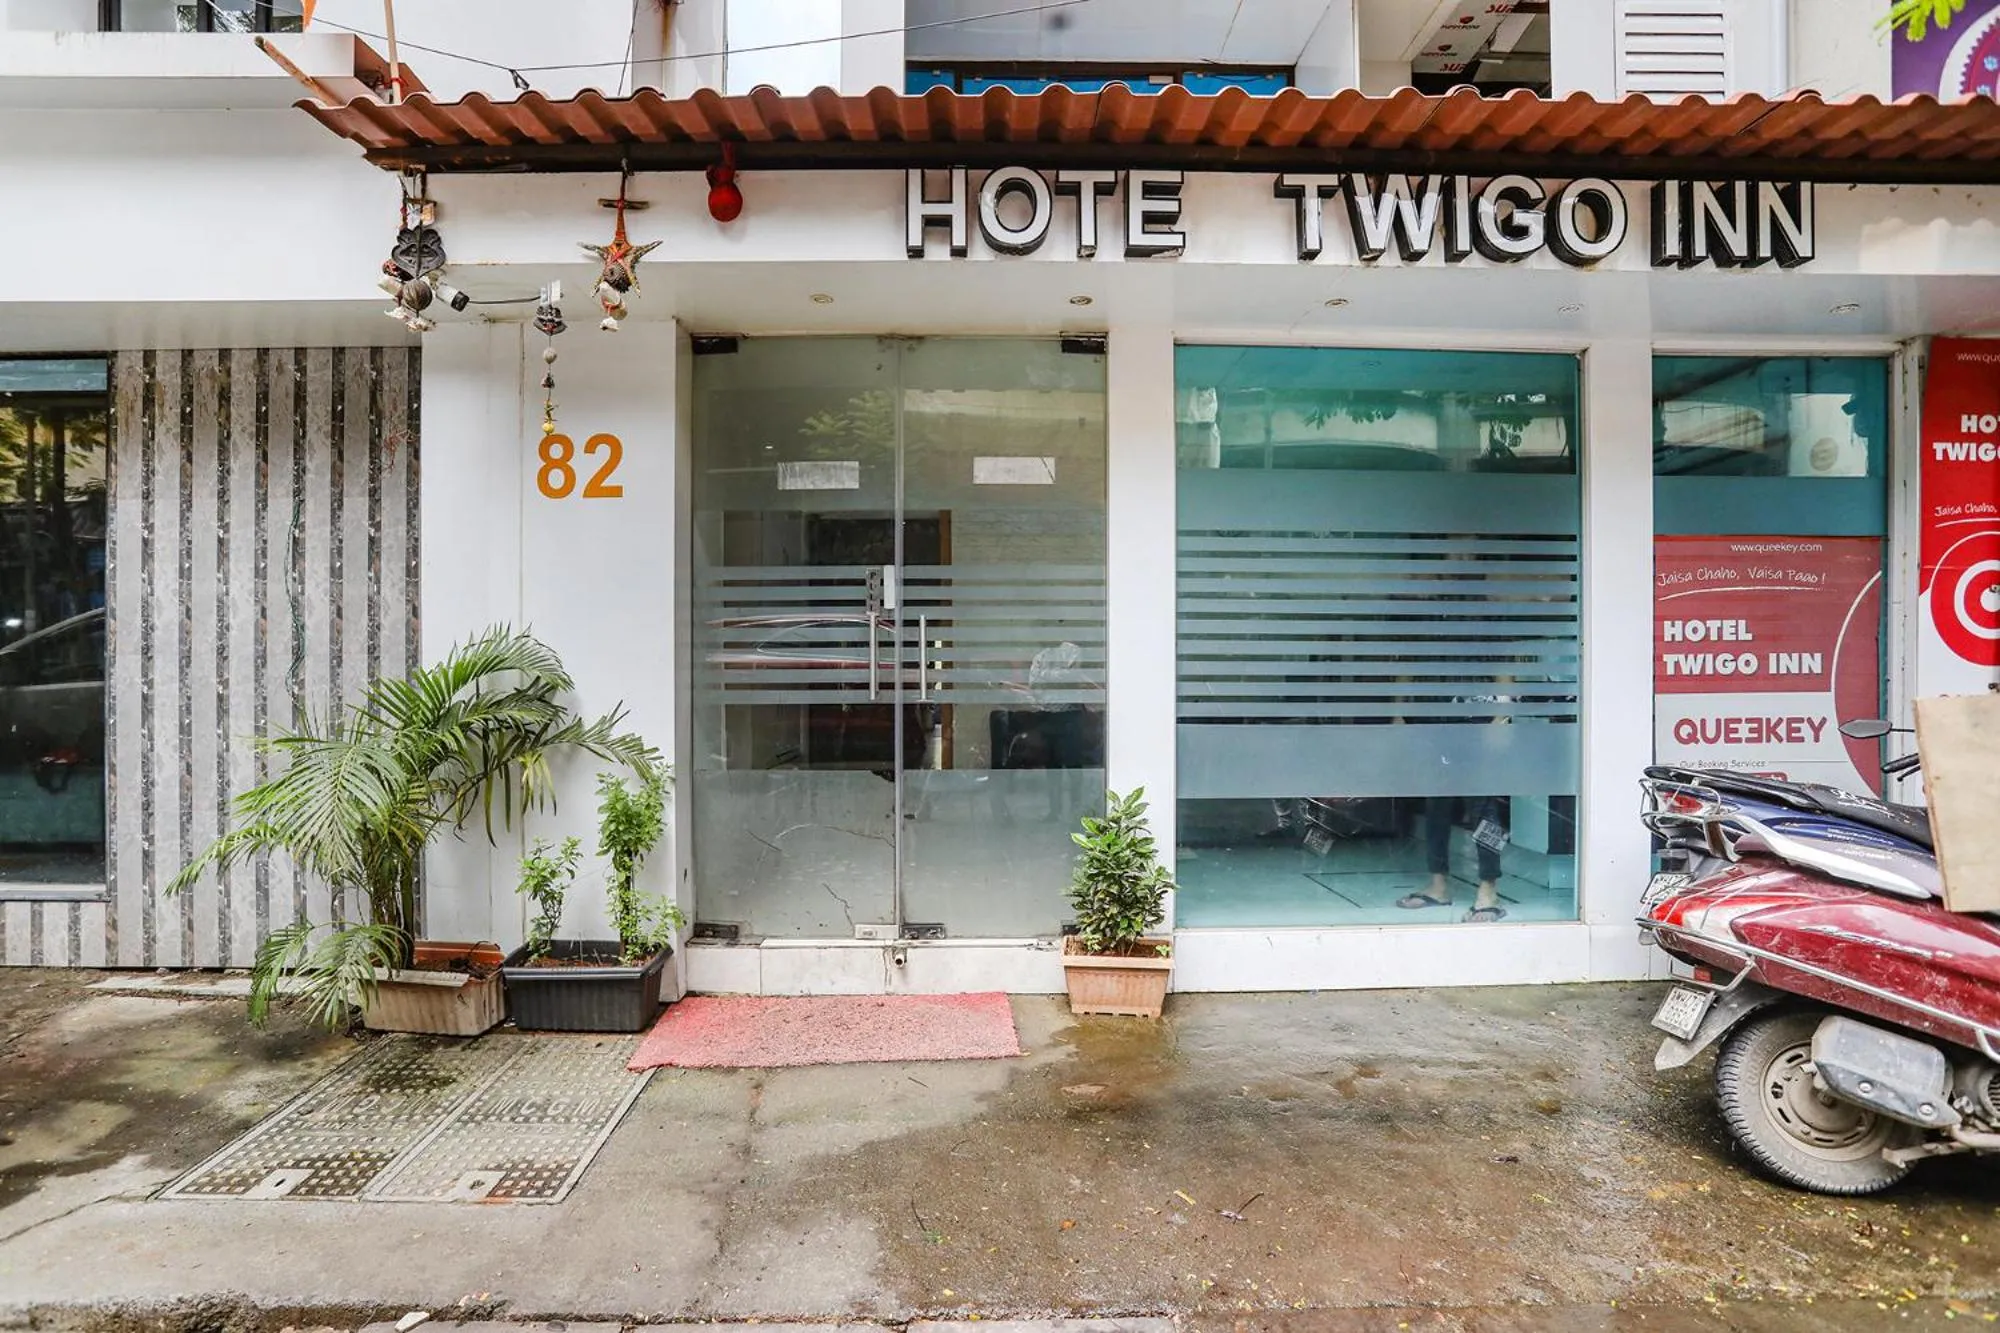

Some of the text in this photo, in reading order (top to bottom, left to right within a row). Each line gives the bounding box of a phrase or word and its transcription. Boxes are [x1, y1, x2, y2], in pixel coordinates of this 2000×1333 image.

[906, 165, 1815, 268] HOTE TWIGO INN
[1961, 414, 2000, 434] HO
[1932, 442, 2000, 463] TWIG
[537, 432, 624, 499] 82
[1730, 543, 1823, 553] www.queekey.com
[1657, 570, 1693, 587] Jaisa
[1747, 566, 1783, 580] Vaisa
[1663, 619, 1753, 642] HOTEL
[1663, 652, 1823, 677] TWIGO INN
[1674, 715, 1828, 745] QUEEKEY
[1698, 759, 1729, 769] Booking
[1731, 759, 1766, 768] Services
